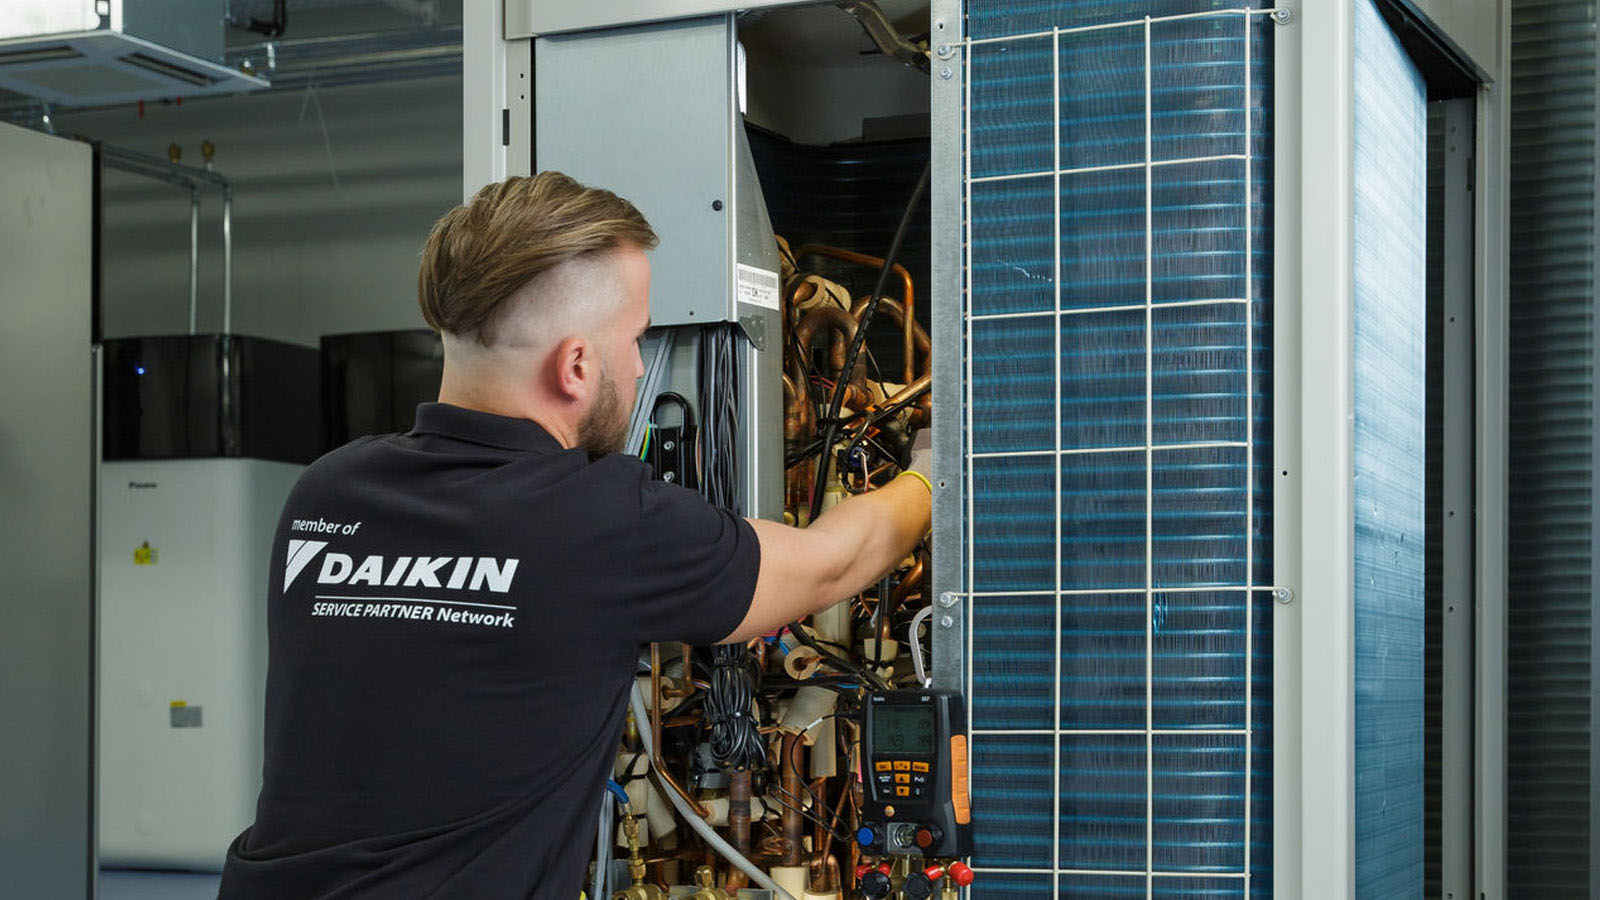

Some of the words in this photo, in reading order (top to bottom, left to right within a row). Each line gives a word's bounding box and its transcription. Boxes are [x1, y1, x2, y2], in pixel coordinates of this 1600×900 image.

[292, 518, 341, 534] member
[342, 521, 362, 536] of
[316, 552, 520, 593] DAIKIN
[312, 602, 362, 617] SERVICE
[363, 604, 434, 621] PARTNER
[436, 607, 516, 628] Network
